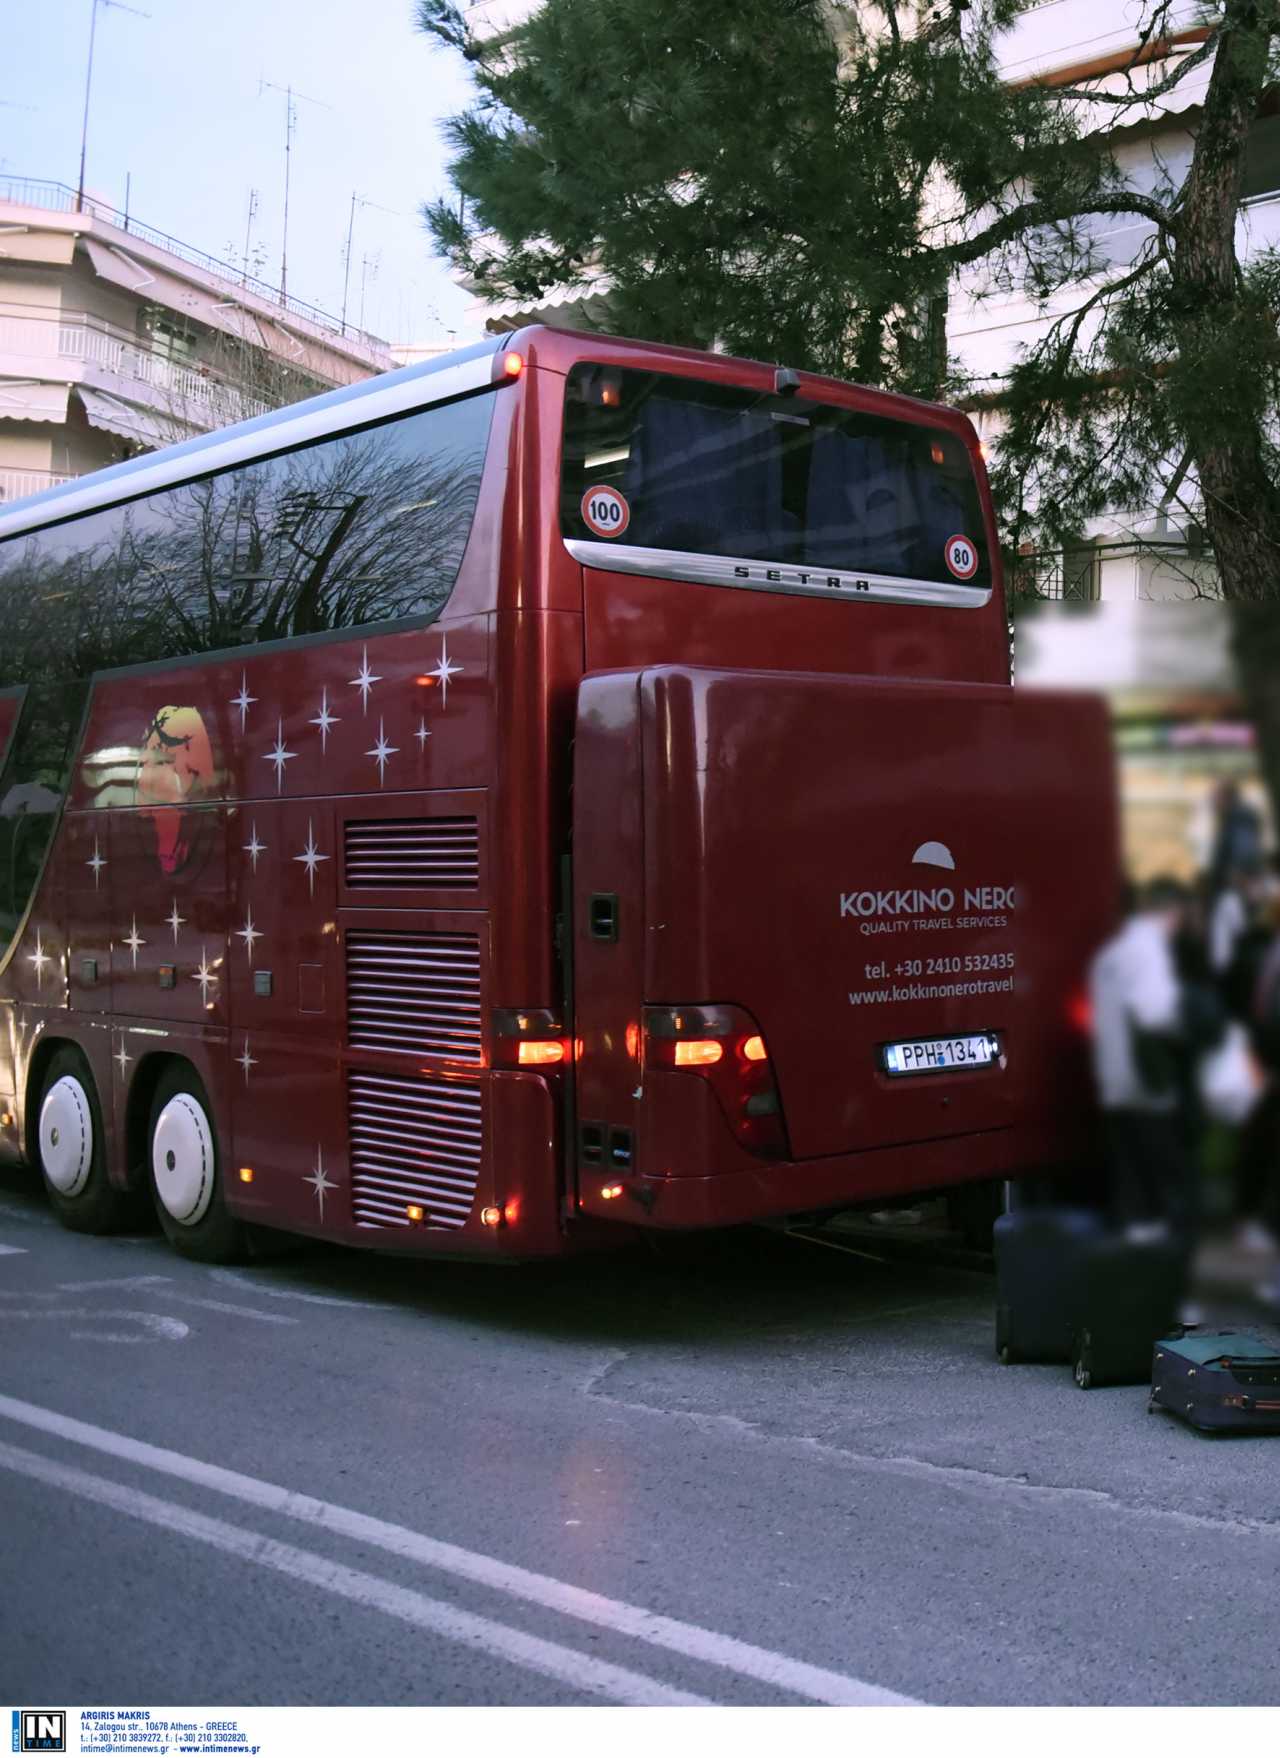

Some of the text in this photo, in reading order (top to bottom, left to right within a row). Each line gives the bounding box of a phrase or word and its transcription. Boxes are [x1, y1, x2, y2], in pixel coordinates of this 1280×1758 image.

[591, 500, 620, 522] 100
[954, 548, 969, 566] 80
[734, 566, 869, 591] SETRA
[840, 888, 955, 917] KOKKINO
[860, 916, 1007, 935] QUALITY TRAVEL SERVICES
[865, 953, 1015, 979] tel. +30 2410 532435
[849, 976, 1014, 1005] www.kokkinonerotravel
